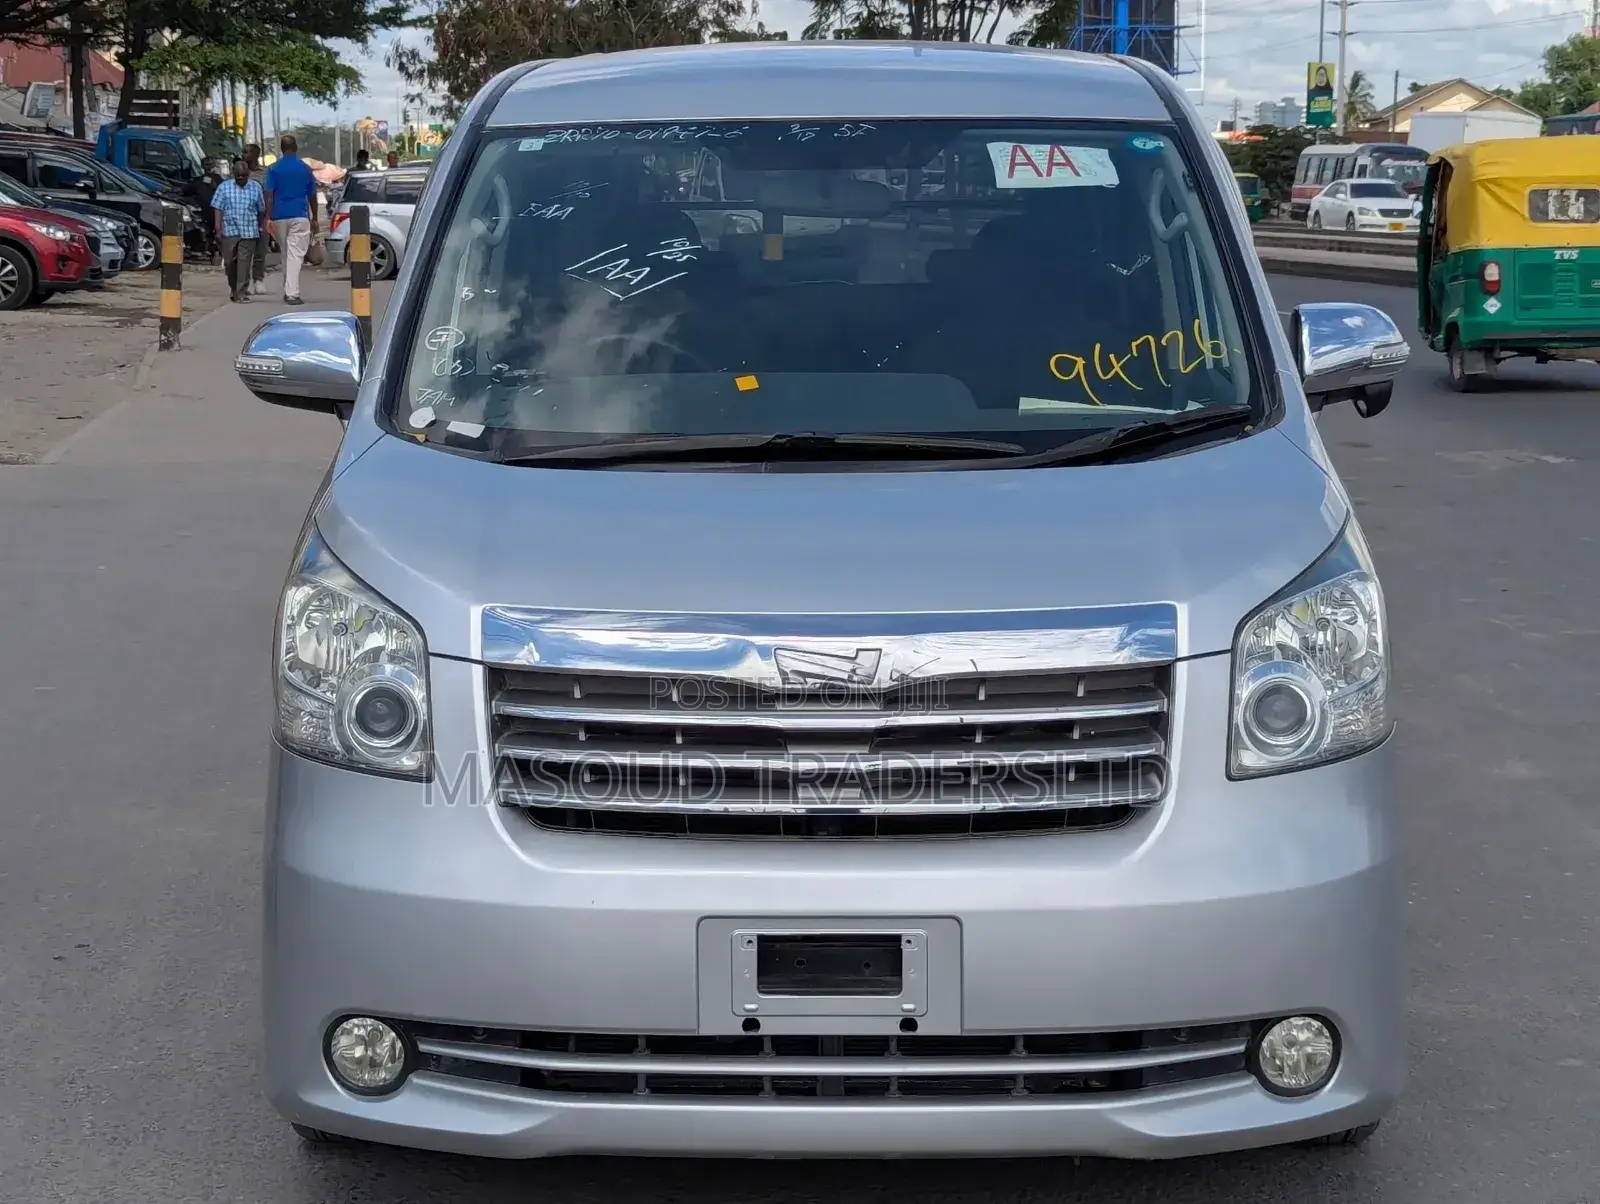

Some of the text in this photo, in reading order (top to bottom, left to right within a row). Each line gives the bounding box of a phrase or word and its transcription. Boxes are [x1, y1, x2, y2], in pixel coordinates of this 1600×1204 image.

[1007, 144, 1082, 179] AA
[1553, 250, 1580, 260] TVS
[1049, 318, 1228, 407] 94726
